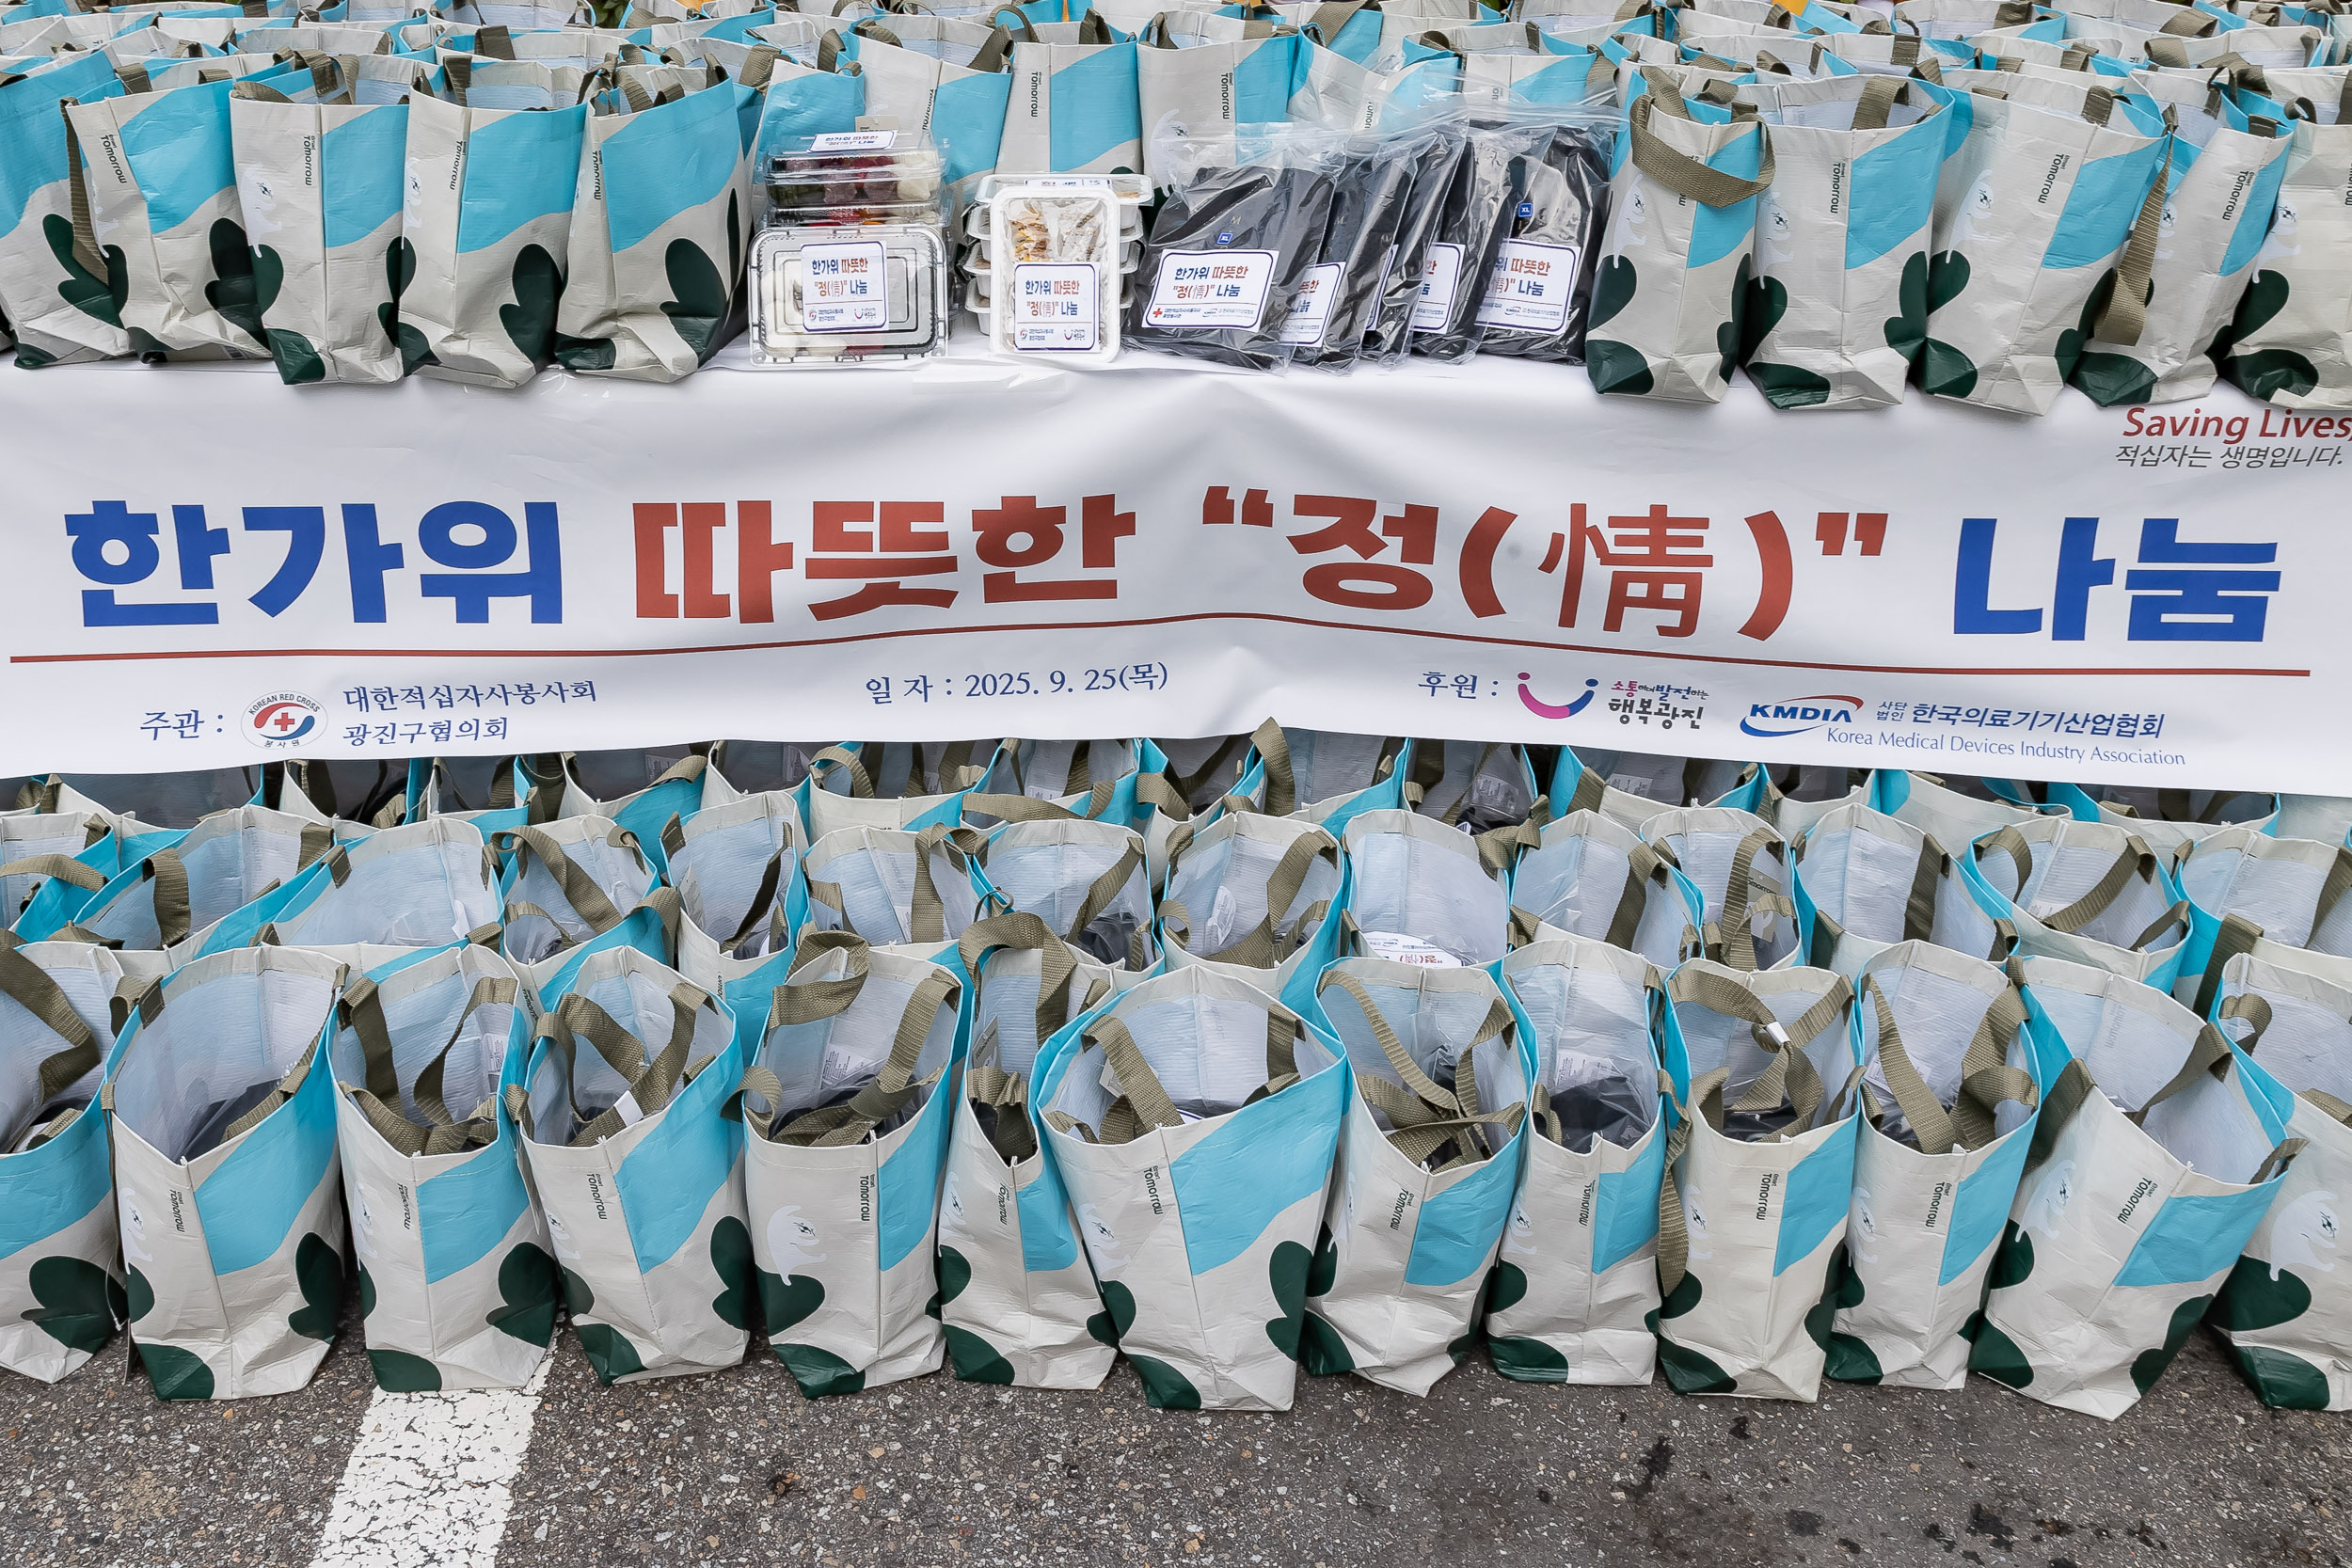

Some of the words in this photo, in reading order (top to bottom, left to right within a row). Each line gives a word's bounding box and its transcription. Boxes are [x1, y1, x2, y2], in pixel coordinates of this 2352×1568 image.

[1221, 73, 1230, 119] Tomorrow
[101, 135, 127, 184] Tomorrow
[304, 135, 312, 186] Tomorrow
[450, 141, 463, 191] Tomorrow
[1830, 163, 1841, 214] Tomorrow
[2038, 154, 2064, 204] Tomorrow
[2222, 170, 2249, 220] Tomorrow
[812, 259, 838, 275] 한가위
[841, 258, 868, 273] 따뜻한
[1175, 266, 1210, 280] 한가위
[1212, 265, 1248, 279] 따뜻한
[1510, 258, 1550, 276] 따뜻한
[850, 279, 867, 294] 나눔
[1025, 280, 1052, 295] 한가위
[1054, 280, 1079, 295] 따뜻한
[1216, 284, 1241, 297] 나눔
[1298, 279, 1319, 294] 뜻한
[1518, 279, 1544, 296] 나눔
[1061, 301, 1078, 316] 나눔
[2122, 406, 2249, 445] Saving
[2115, 444, 2213, 468] 적십자는
[2219, 445, 2343, 468] 생명입니다.
[64, 500, 563, 627] 한가위
[632, 494, 1136, 625] 따뜻한
[1954, 517, 2281, 641] 나눔
[343, 680, 596, 713] 대한적십자사봉사회
[965, 673, 1039, 697] 2025.
[1050, 671, 1073, 693] 9.
[1085, 661, 1168, 691] 25(목)
[1418, 671, 1477, 699] 후원
[248, 695, 278, 715] KOREAN
[296, 696, 320, 712] CROSS
[1608, 698, 1704, 729] 행복광진
[1750, 704, 1852, 723] KMDIA
[1912, 703, 2166, 738] 한국의료기기산업협회
[139, 708, 205, 741] 주관
[342, 717, 508, 747] 광진구협의회
[1827, 727, 1873, 745] Korea
[1878, 731, 1944, 750] Medical
[1951, 736, 2014, 756] Devices
[2021, 740, 2085, 764] Industry
[2090, 746, 2186, 765] Association
[587, 1173, 607, 1220] Tomorrow
[860, 1175, 870, 1222] Tomorrow
[1143, 1167, 1163, 1215] Tomorrow
[1390, 1188, 1409, 1230] Tomorrow
[1756, 1173, 1772, 1220] Tomorrow
[1925, 1181, 1945, 1227] Tomorrow
[2117, 1177, 2152, 1225] Tomorrow
[170, 1189, 185, 1232] Tomorrow
